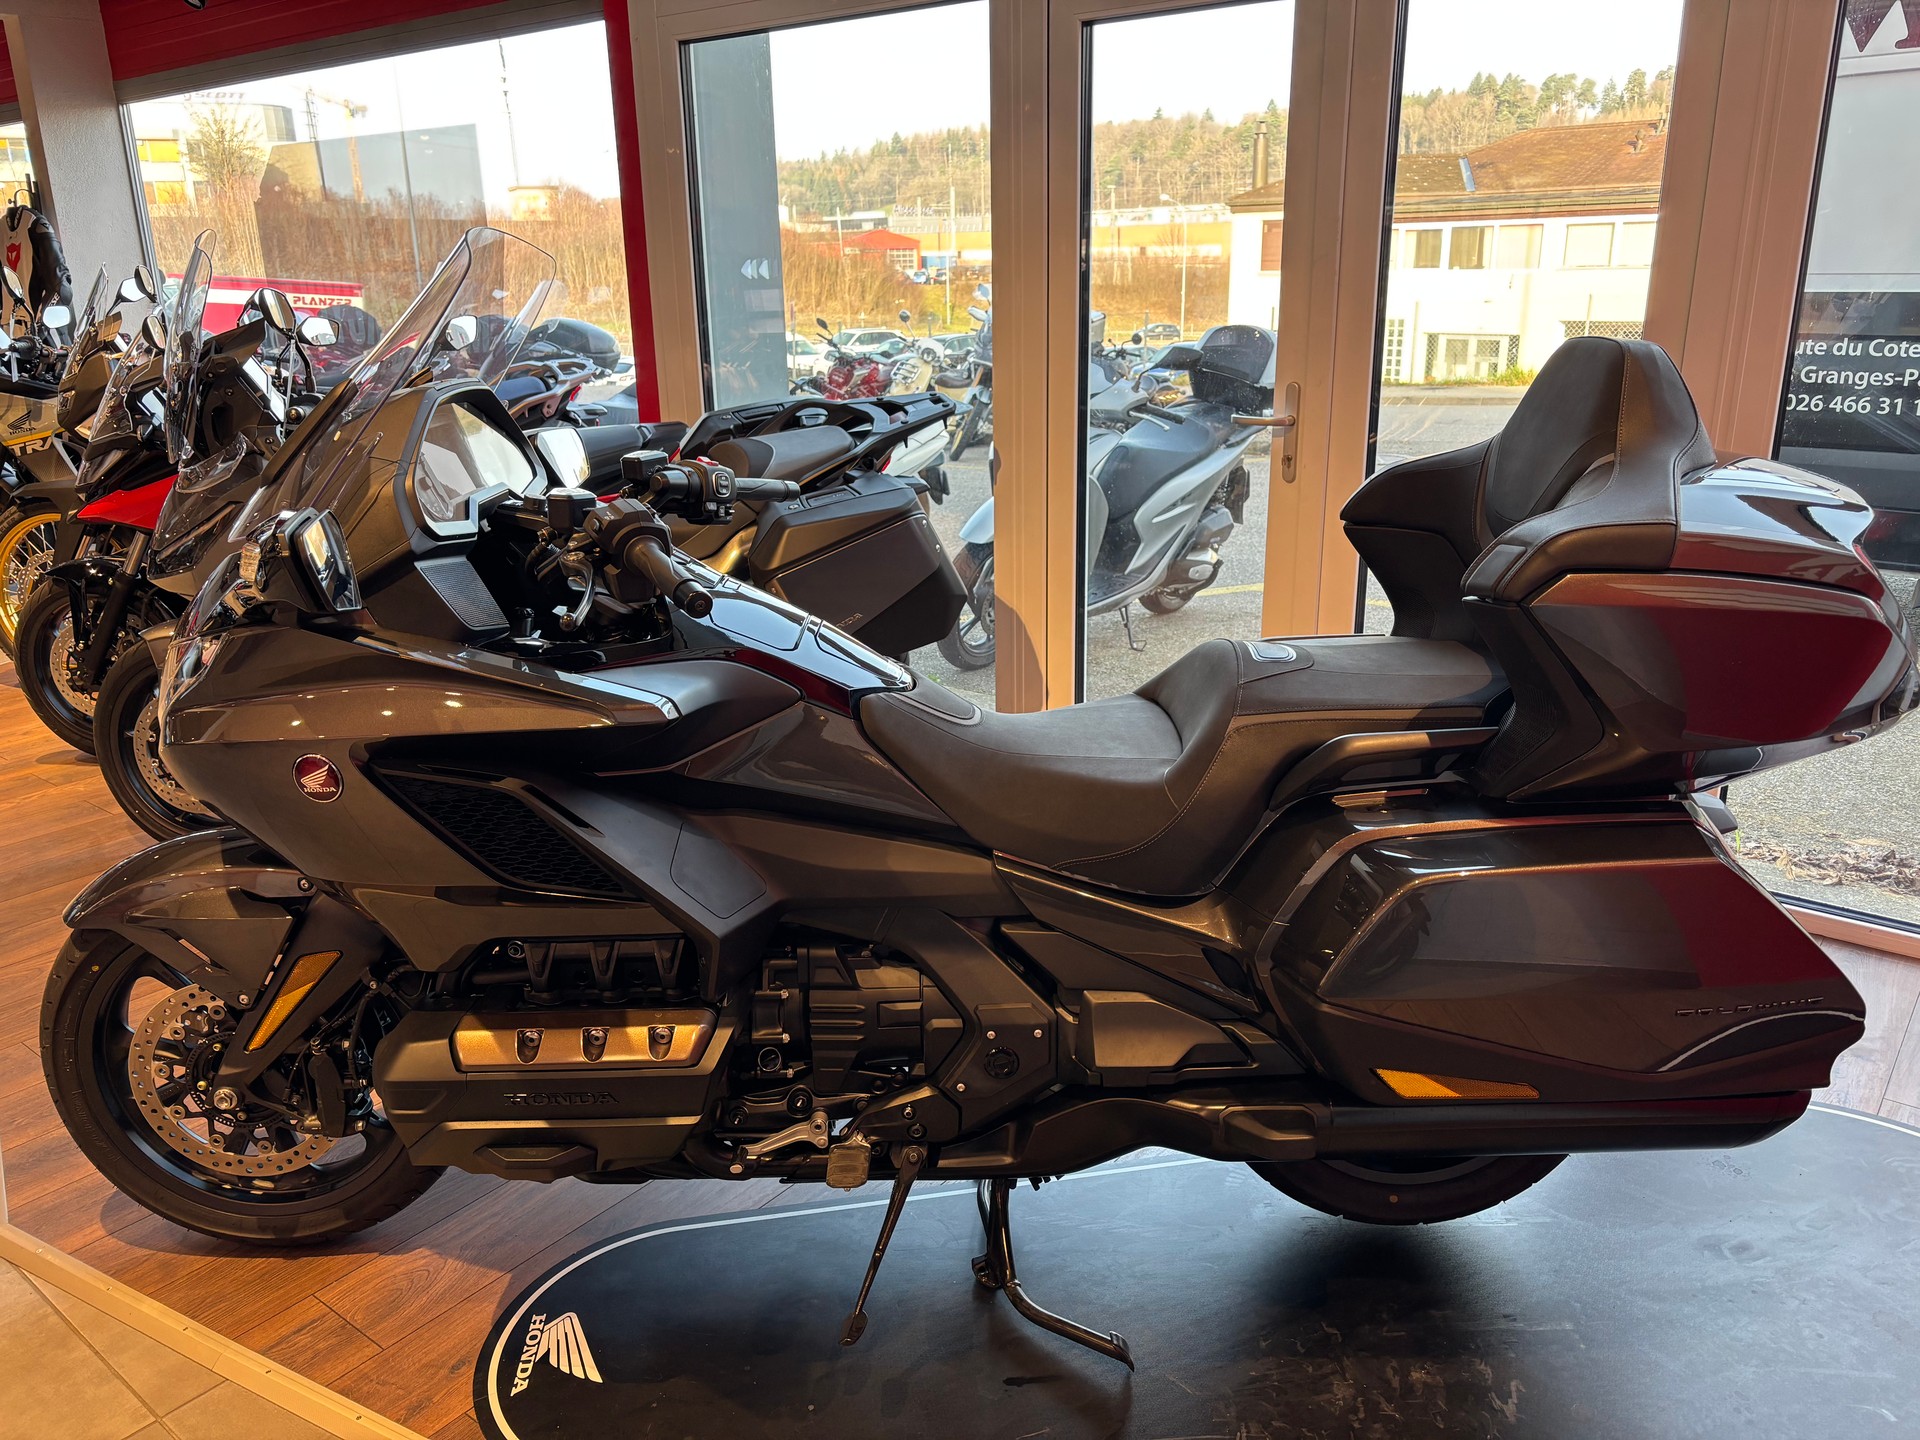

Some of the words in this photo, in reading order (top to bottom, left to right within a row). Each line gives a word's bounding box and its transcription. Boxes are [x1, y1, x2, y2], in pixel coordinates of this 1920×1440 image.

[292, 296, 352, 306] PLANZER
[1832, 337, 1863, 357] du
[1800, 365, 1920, 390] Granges-P
[1828, 395, 1871, 414] 466
[1876, 397, 1903, 416] 31
[9, 426, 37, 436] HONDA
[503, 1091, 620, 1106] HONDA
[510, 1313, 547, 1397] HONDA
